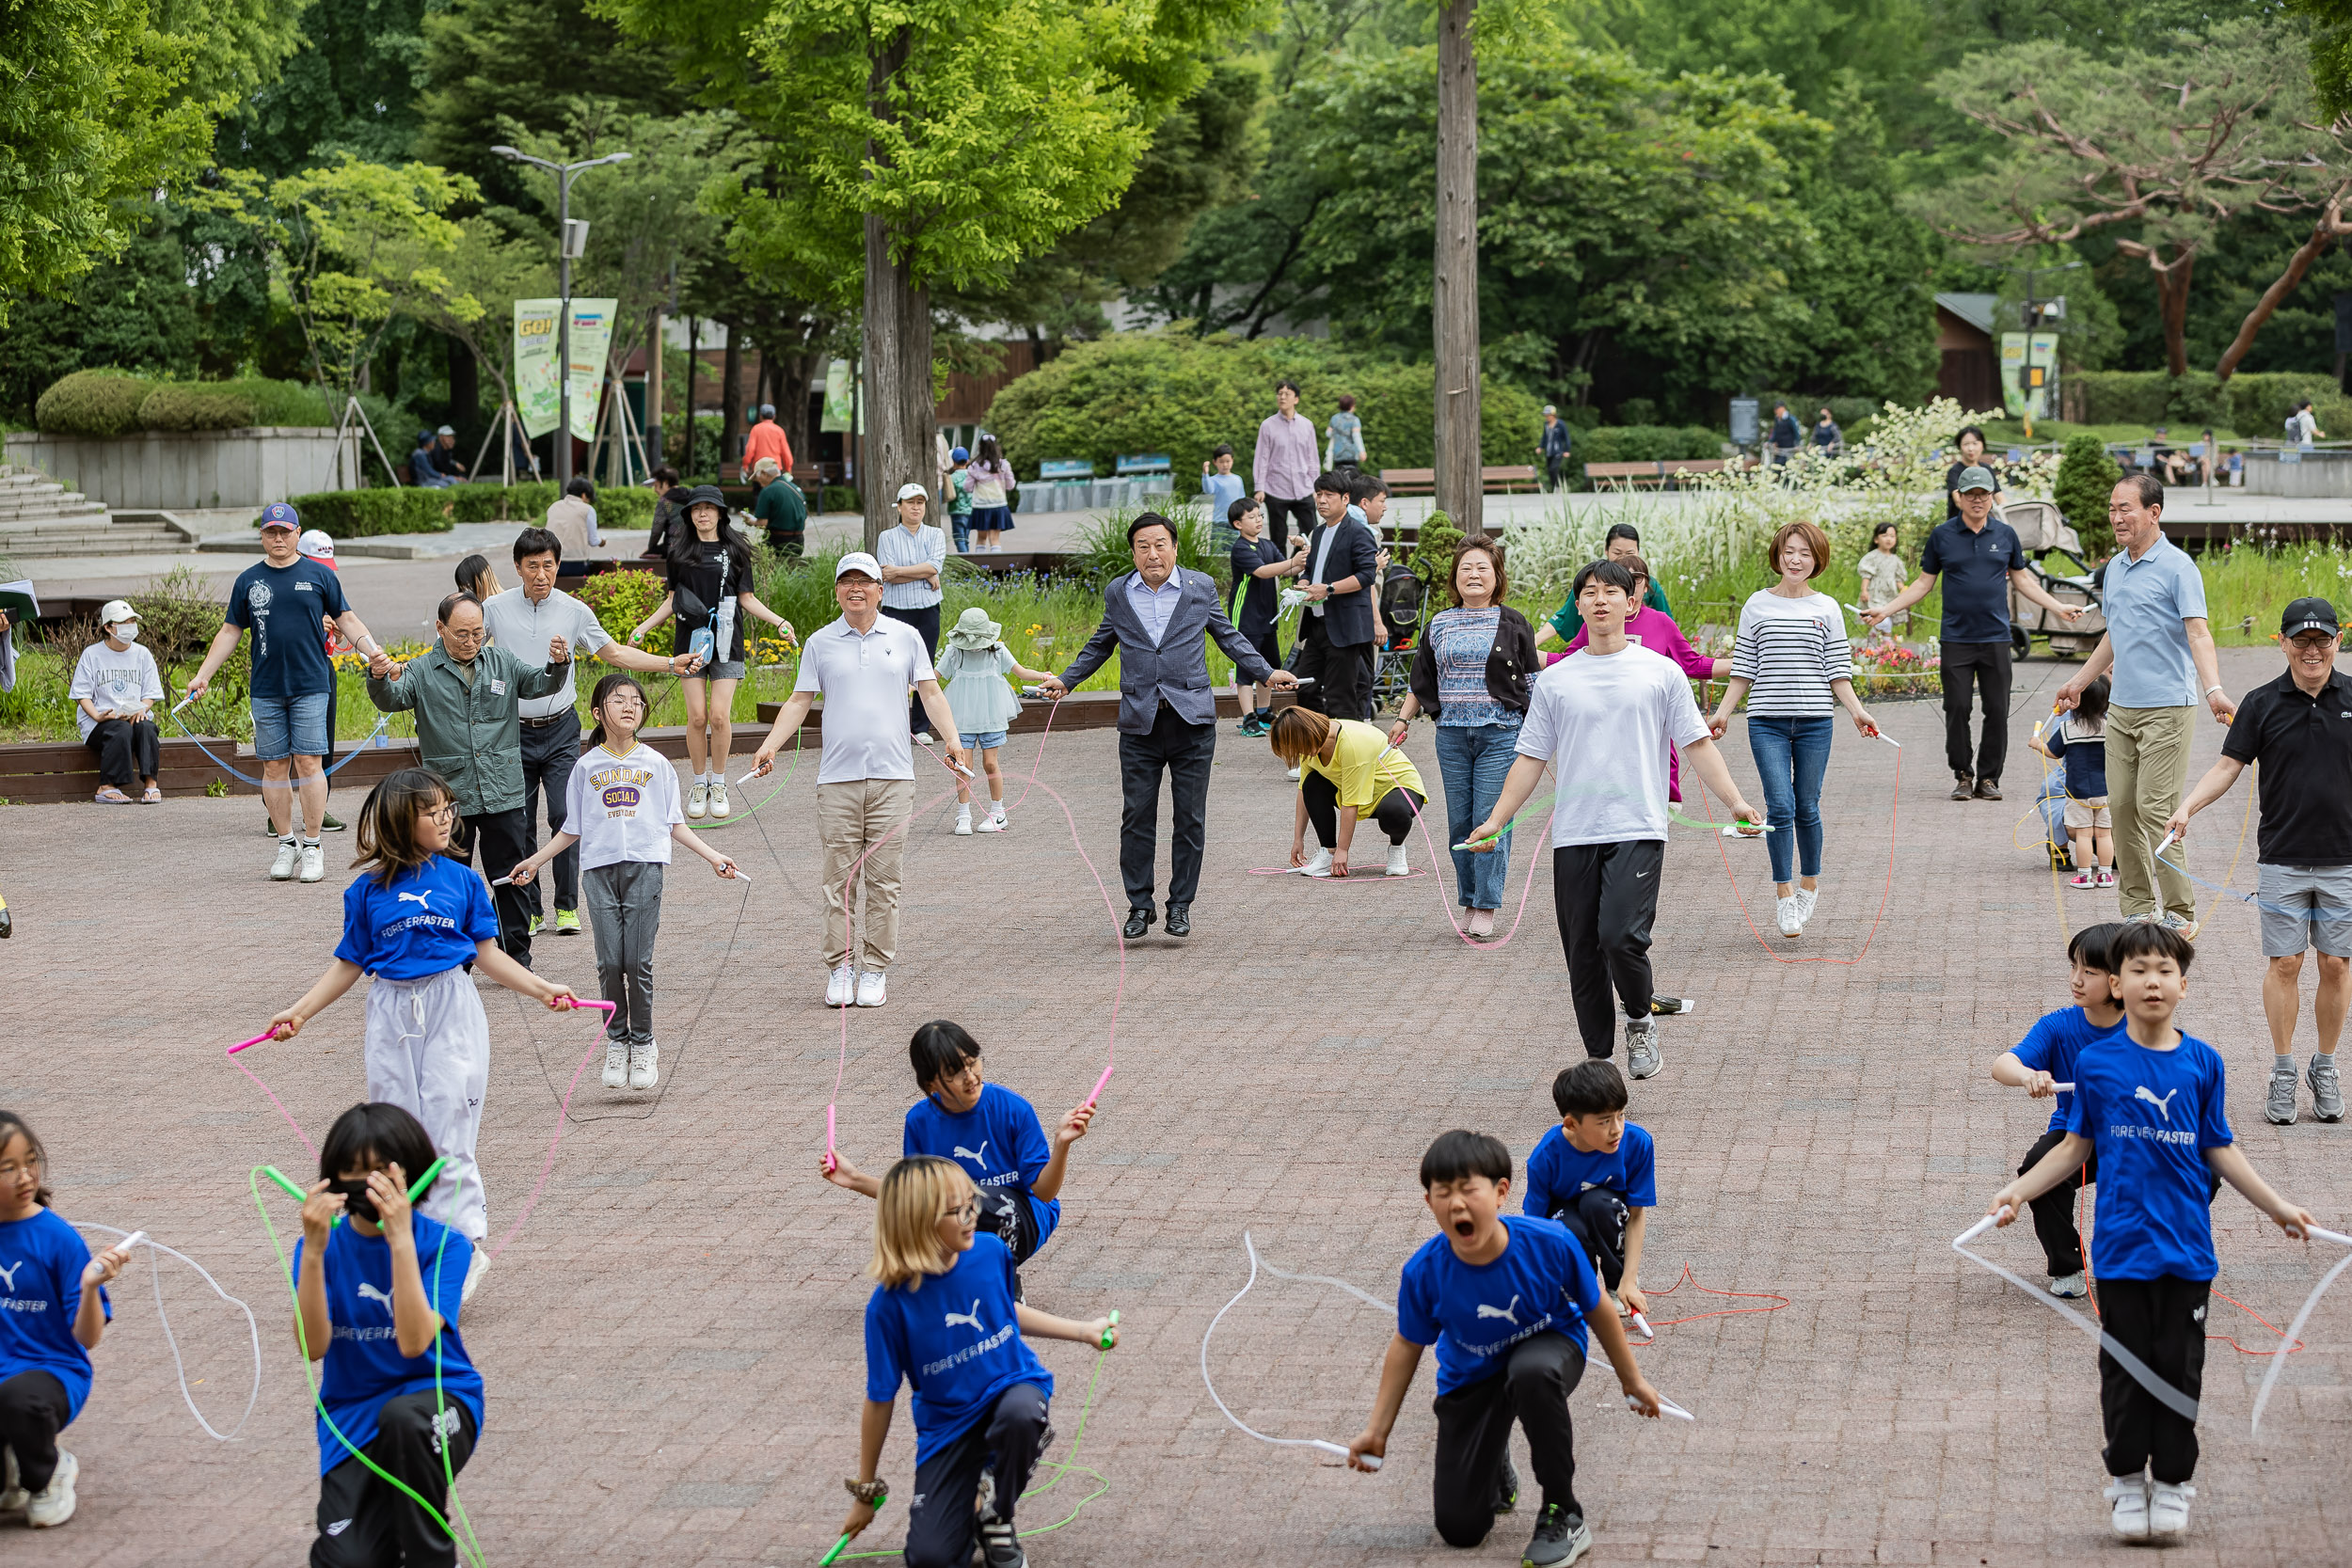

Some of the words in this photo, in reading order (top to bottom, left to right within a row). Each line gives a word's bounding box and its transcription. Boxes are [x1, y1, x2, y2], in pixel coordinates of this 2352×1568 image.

[519, 318, 552, 337] GO!
[96, 669, 142, 688] CALIFORNIA
[589, 768, 653, 791] SUNDAY
[605, 790, 637, 804] SOCIAL
[608, 809, 636, 818] EVERYDAY
